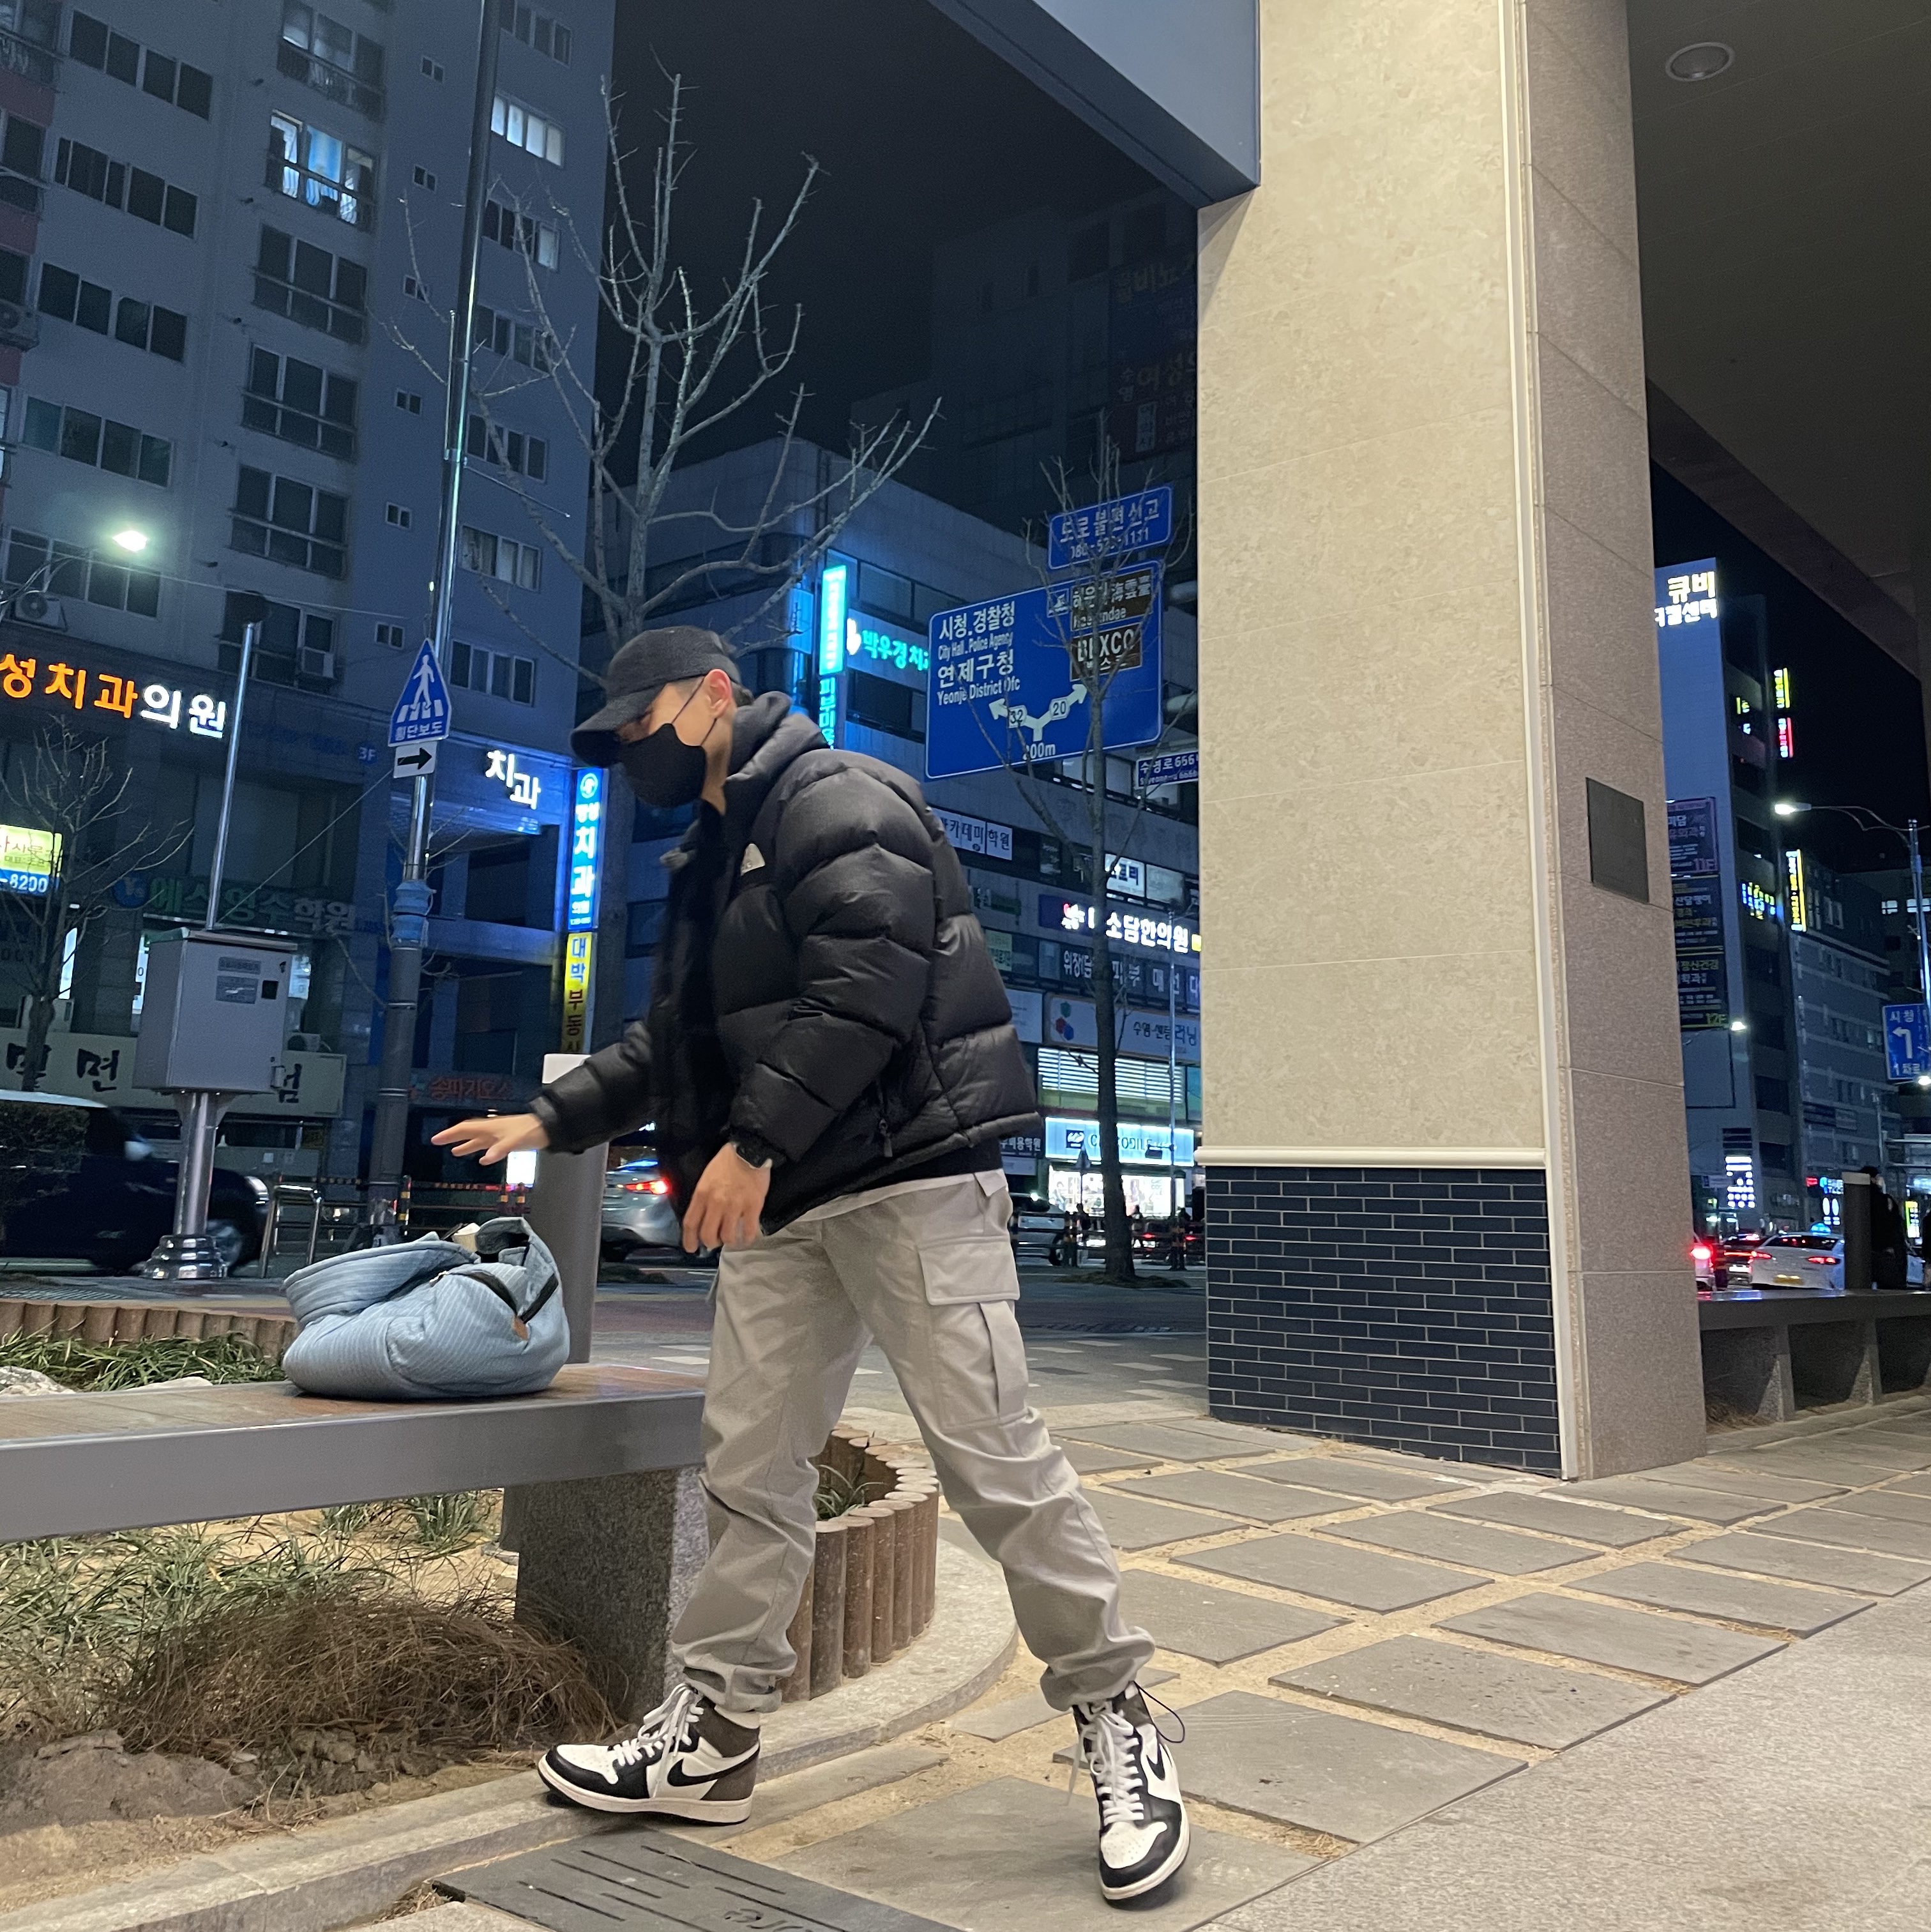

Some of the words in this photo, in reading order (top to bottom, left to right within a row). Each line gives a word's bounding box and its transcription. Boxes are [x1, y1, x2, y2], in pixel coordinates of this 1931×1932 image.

[1667, 570, 1716, 604] 큐비
[937, 649, 1014, 688] 연제구청
[937, 687, 968, 706] Yeonje
[969, 680, 1003, 699] District
[1010, 710, 1024, 724] 32
[1052, 701, 1067, 717] 20
[395, 720, 443, 742] 횡단보도
[485, 750, 541, 810] 치과
[988, 829, 1010, 851] 학원
[1105, 911, 1190, 954] 소담한의원
